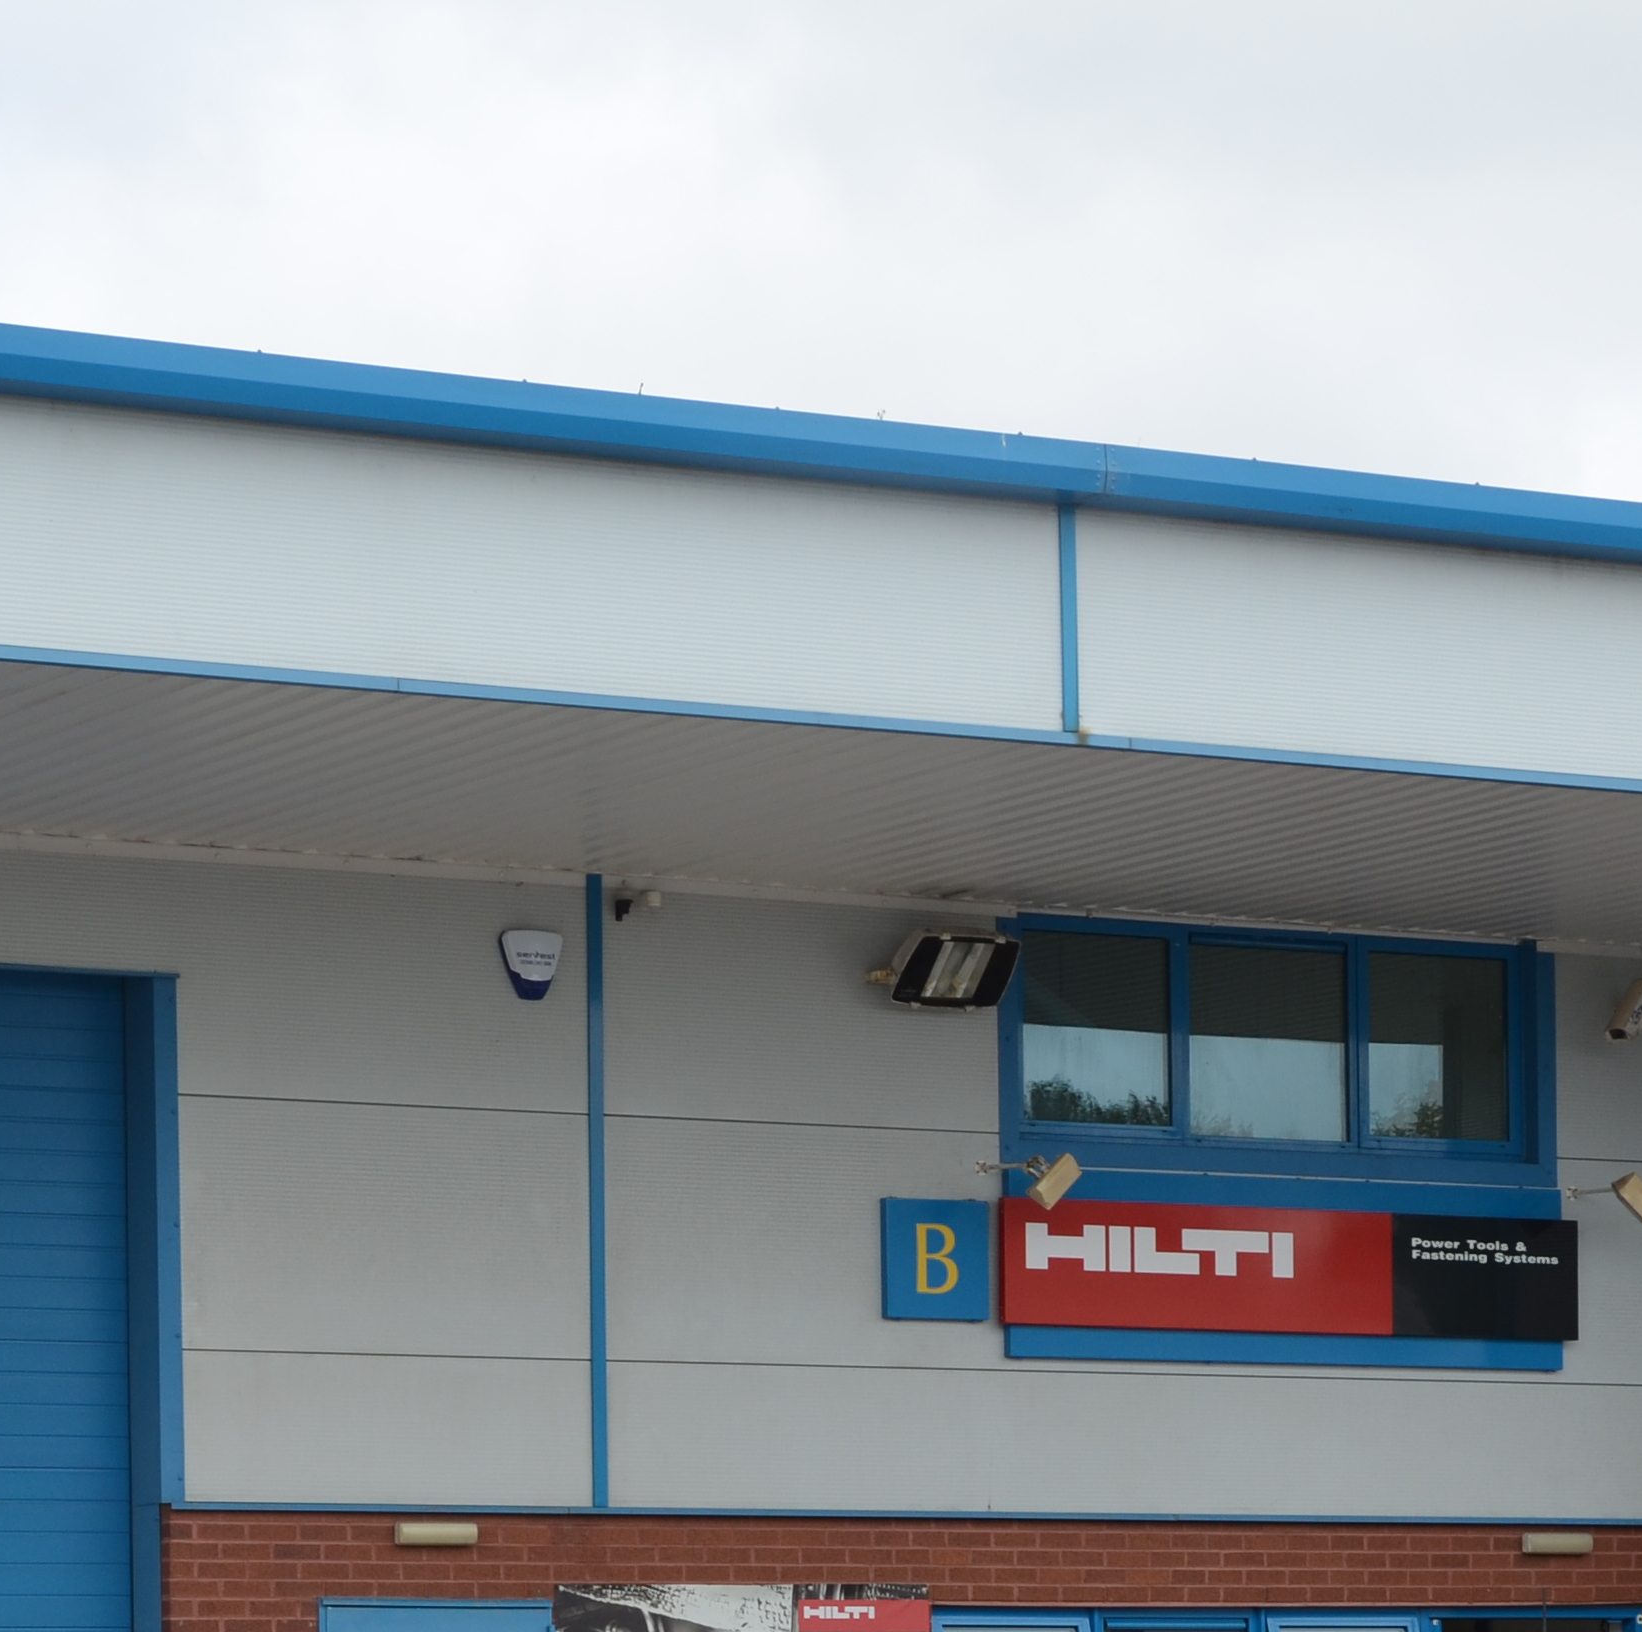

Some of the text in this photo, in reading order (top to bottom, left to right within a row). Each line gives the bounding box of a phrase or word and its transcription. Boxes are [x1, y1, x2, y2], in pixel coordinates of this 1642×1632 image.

[1024, 1221, 1294, 1278] HILTI
[1411, 1237, 1527, 1252] Power Tools &
[915, 1222, 959, 1294] B
[1411, 1249, 1559, 1265] Fastening Systems
[803, 1605, 875, 1619] HILTI
